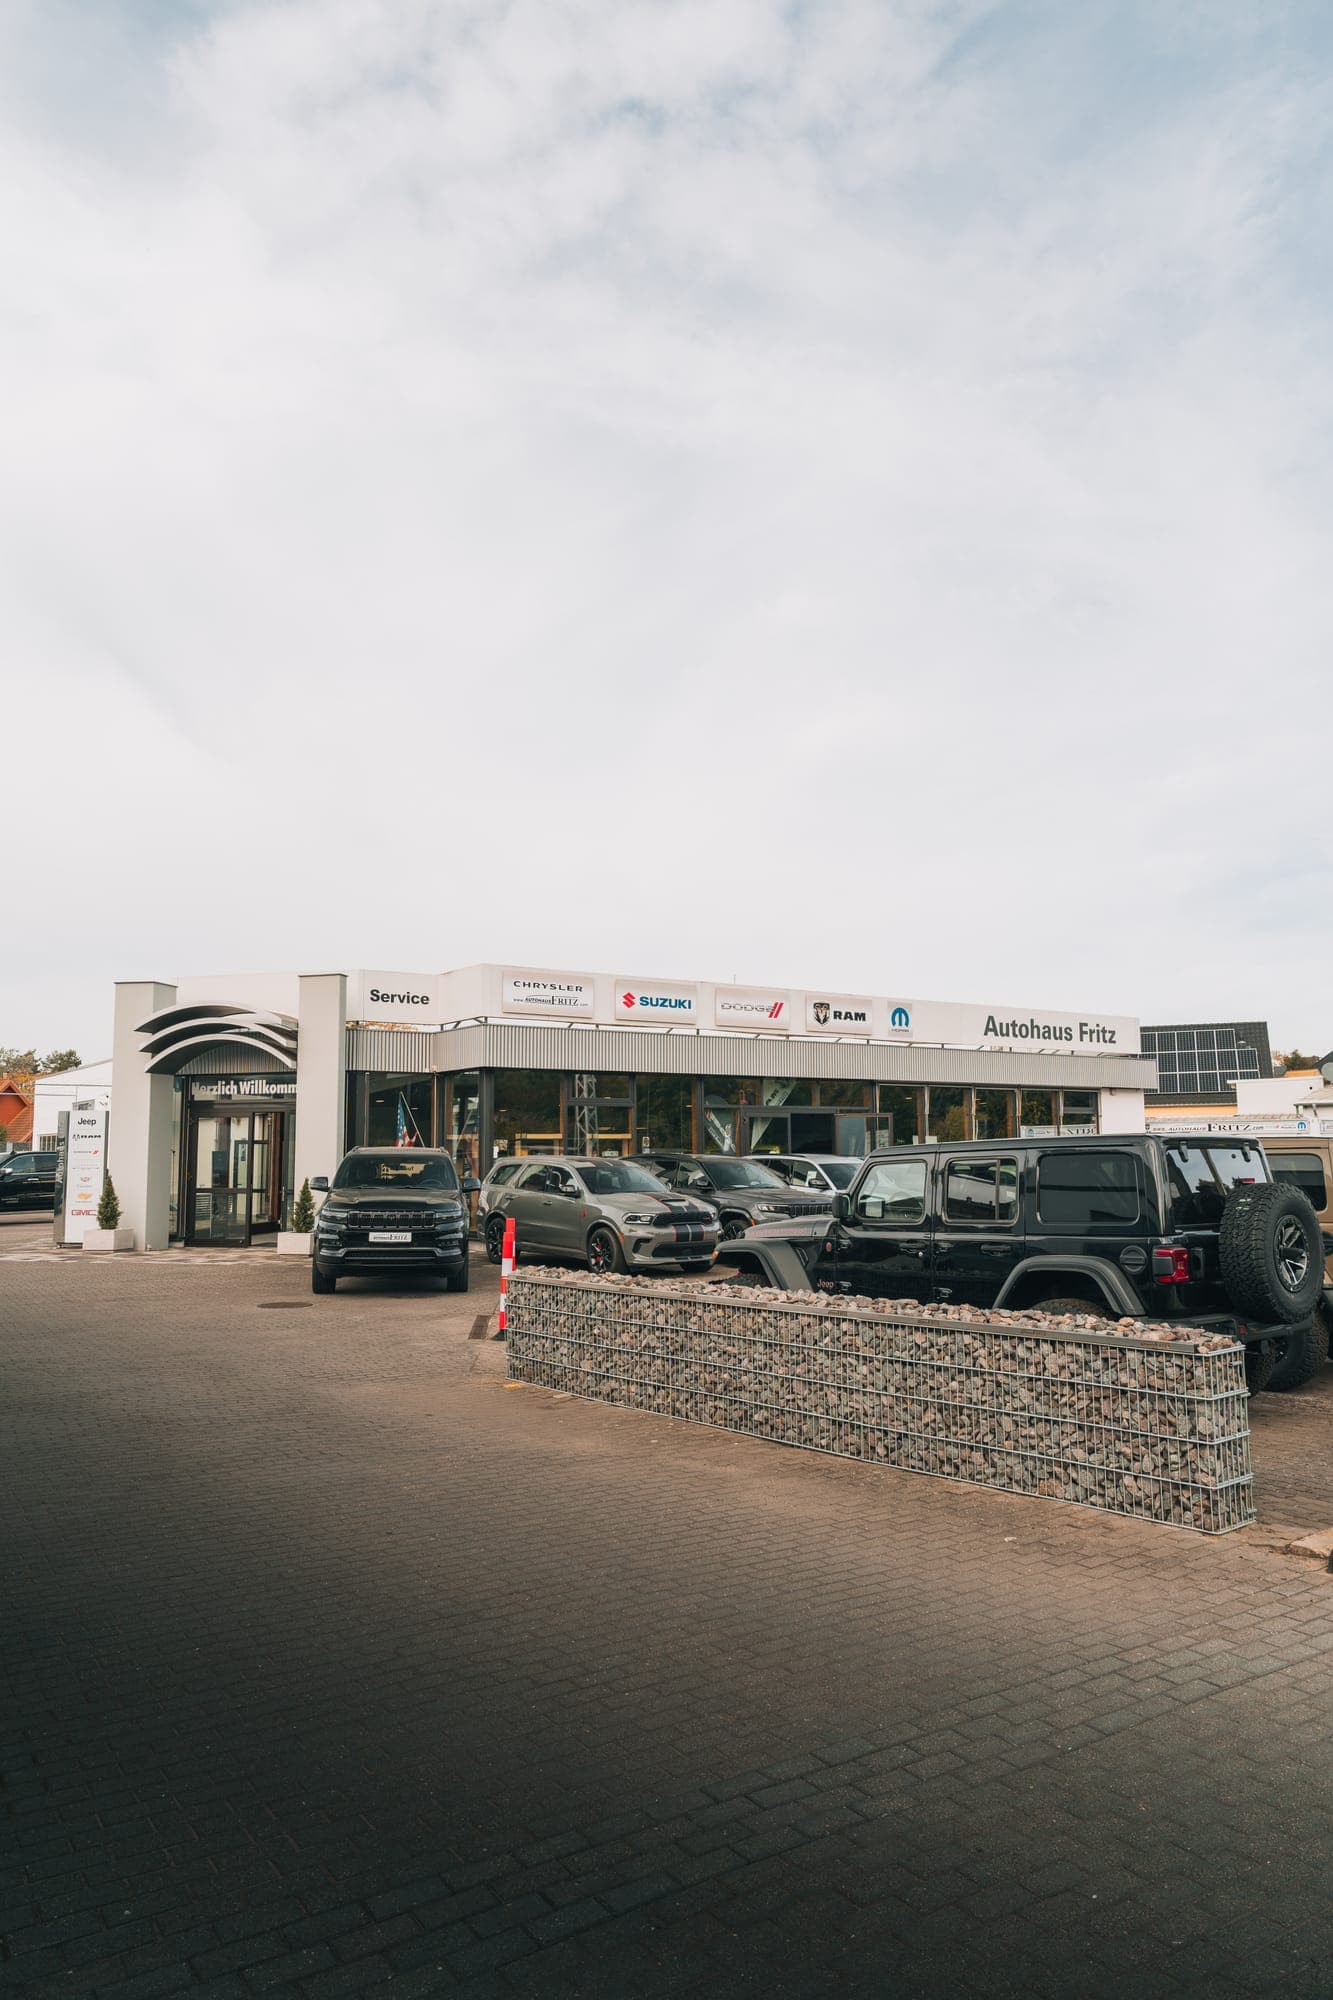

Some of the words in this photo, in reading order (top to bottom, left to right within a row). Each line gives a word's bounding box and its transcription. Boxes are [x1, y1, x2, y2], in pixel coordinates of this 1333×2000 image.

[513, 980, 583, 992] CHRYSLER
[369, 988, 430, 1006] Service
[639, 994, 692, 1011] SUZUKI
[833, 1010, 867, 1022] RAM
[984, 1014, 1073, 1042] Autohaus
[1079, 1022, 1117, 1045] Fritz
[77, 1117, 97, 1127] Jeep
[71, 1209, 97, 1217] GMC
[817, 1279, 834, 1289] Jeep
